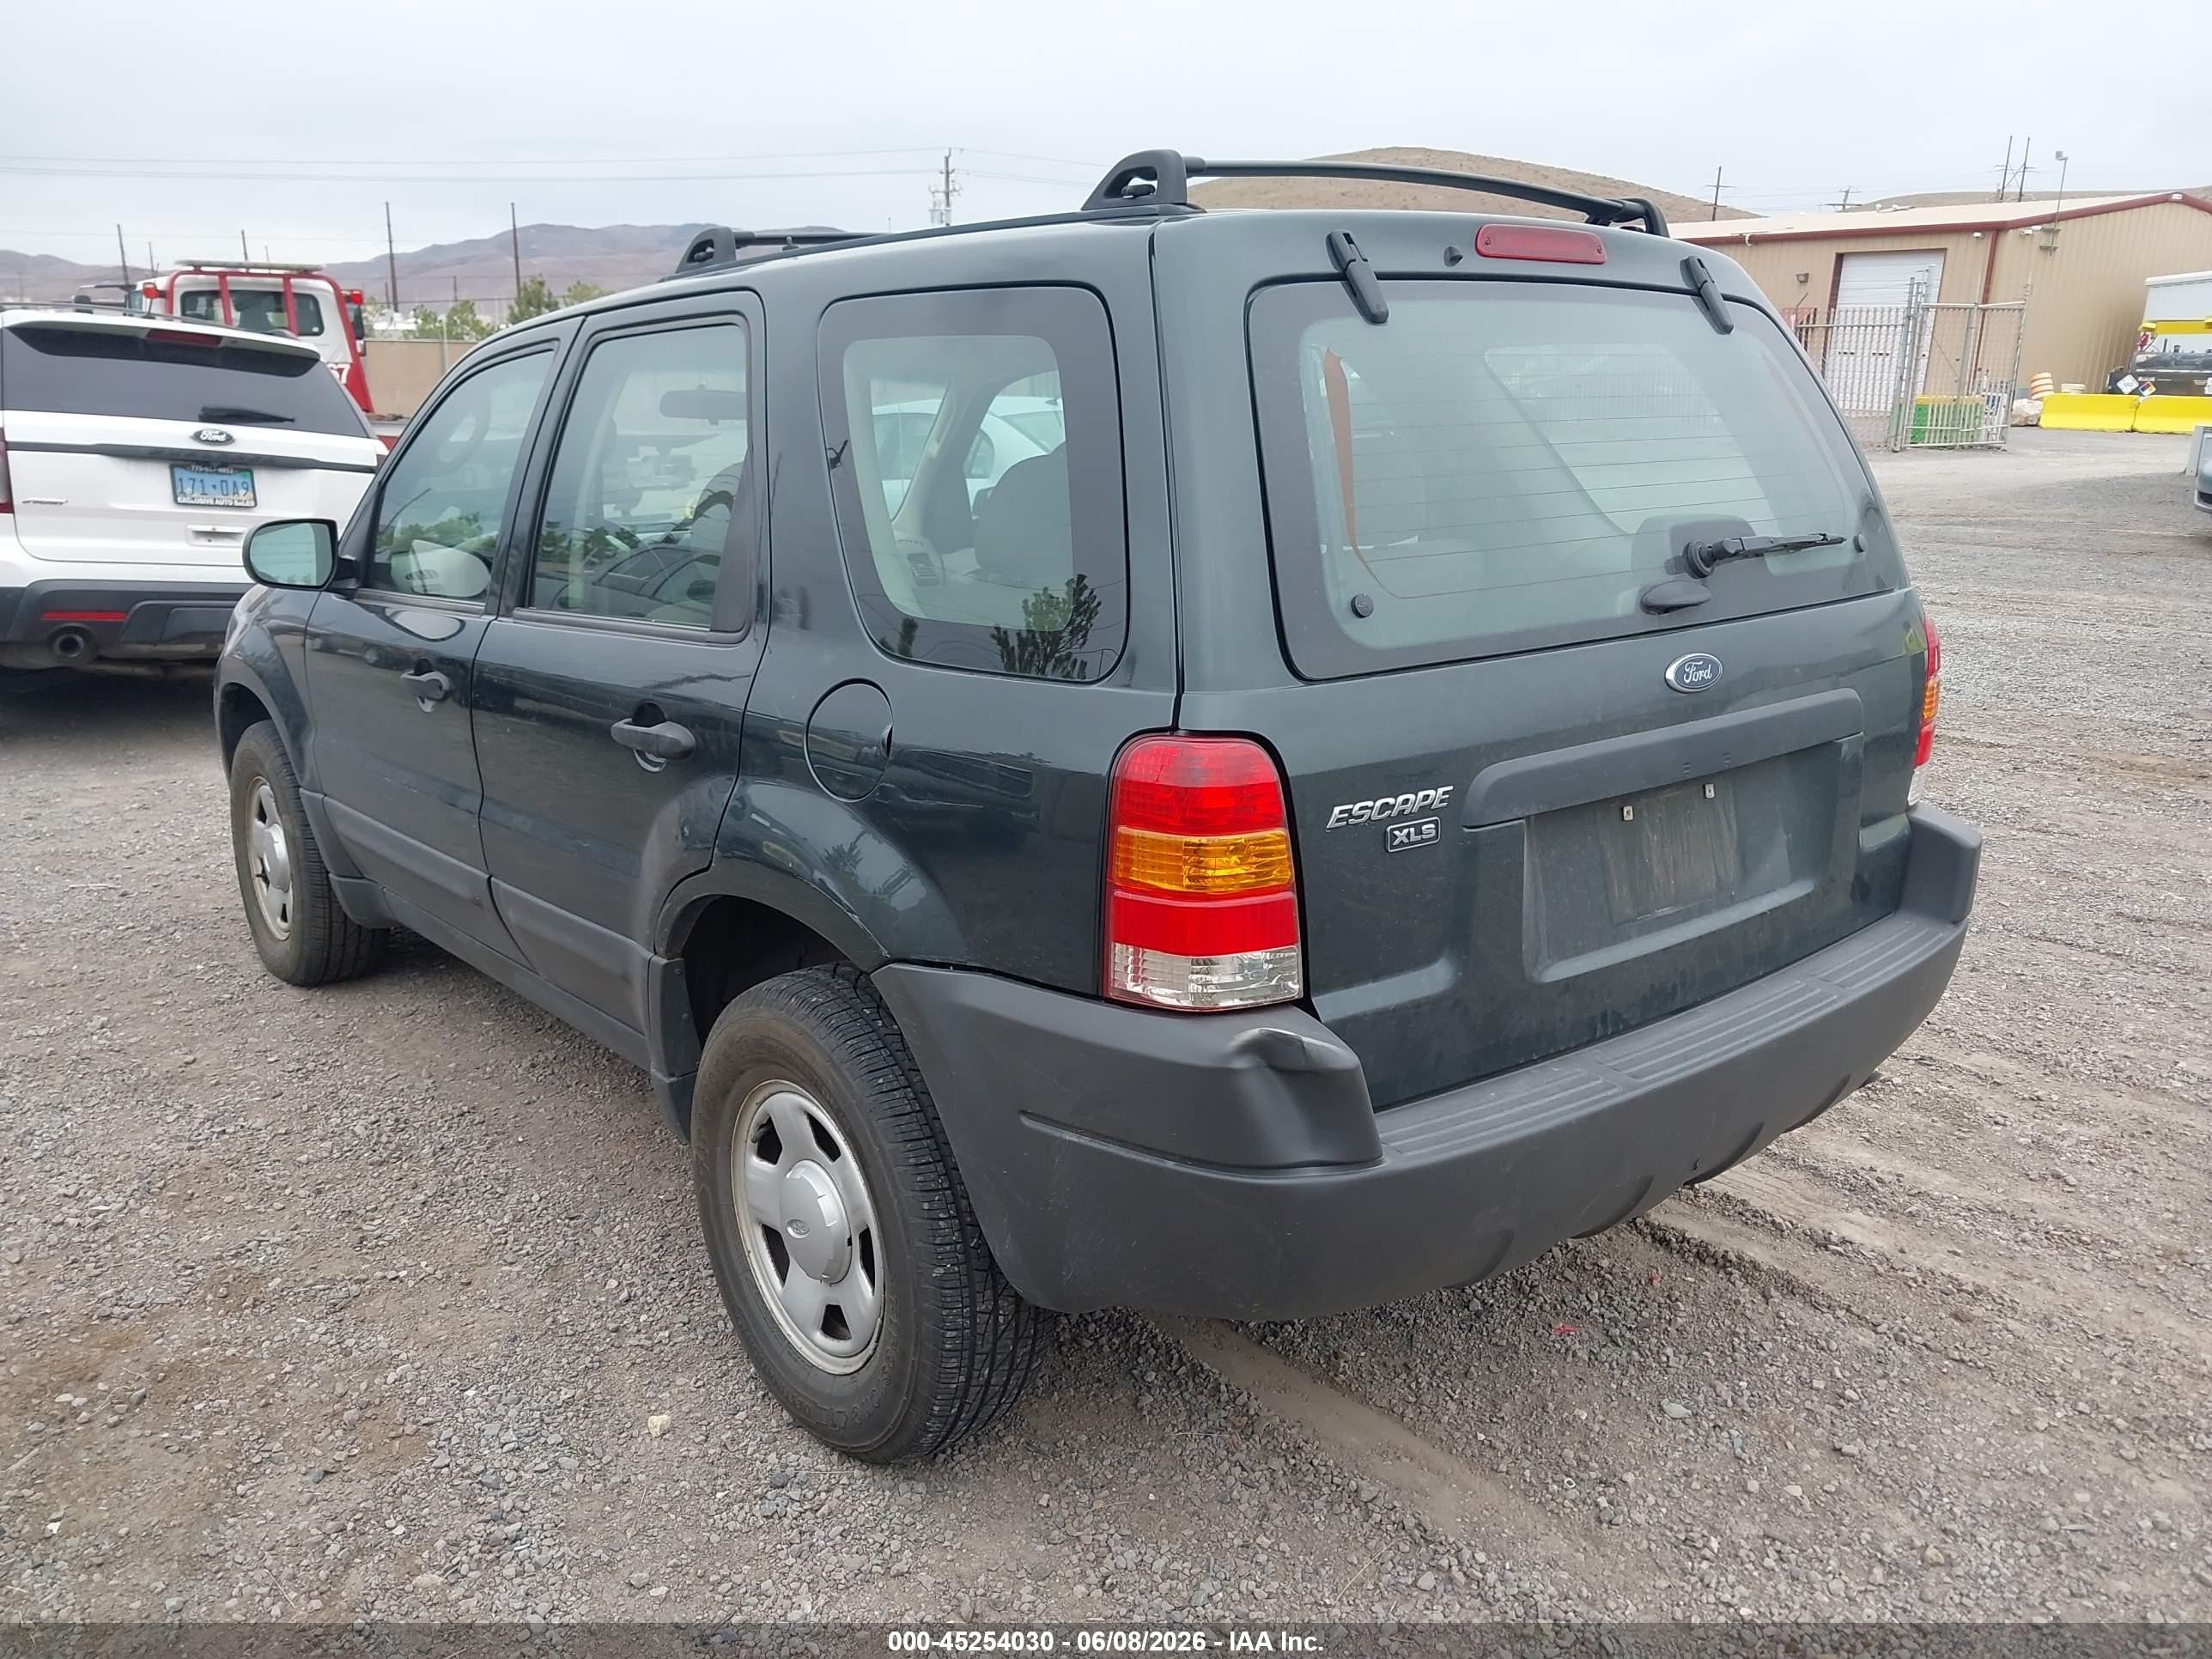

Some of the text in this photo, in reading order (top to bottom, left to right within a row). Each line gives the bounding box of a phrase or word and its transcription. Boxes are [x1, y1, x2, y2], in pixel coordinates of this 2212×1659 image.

[200, 430, 226, 442] Ford
[1683, 660, 1713, 684] Ford
[1326, 786, 1454, 829] ESCAPE
[1393, 823, 1436, 846] XLS
